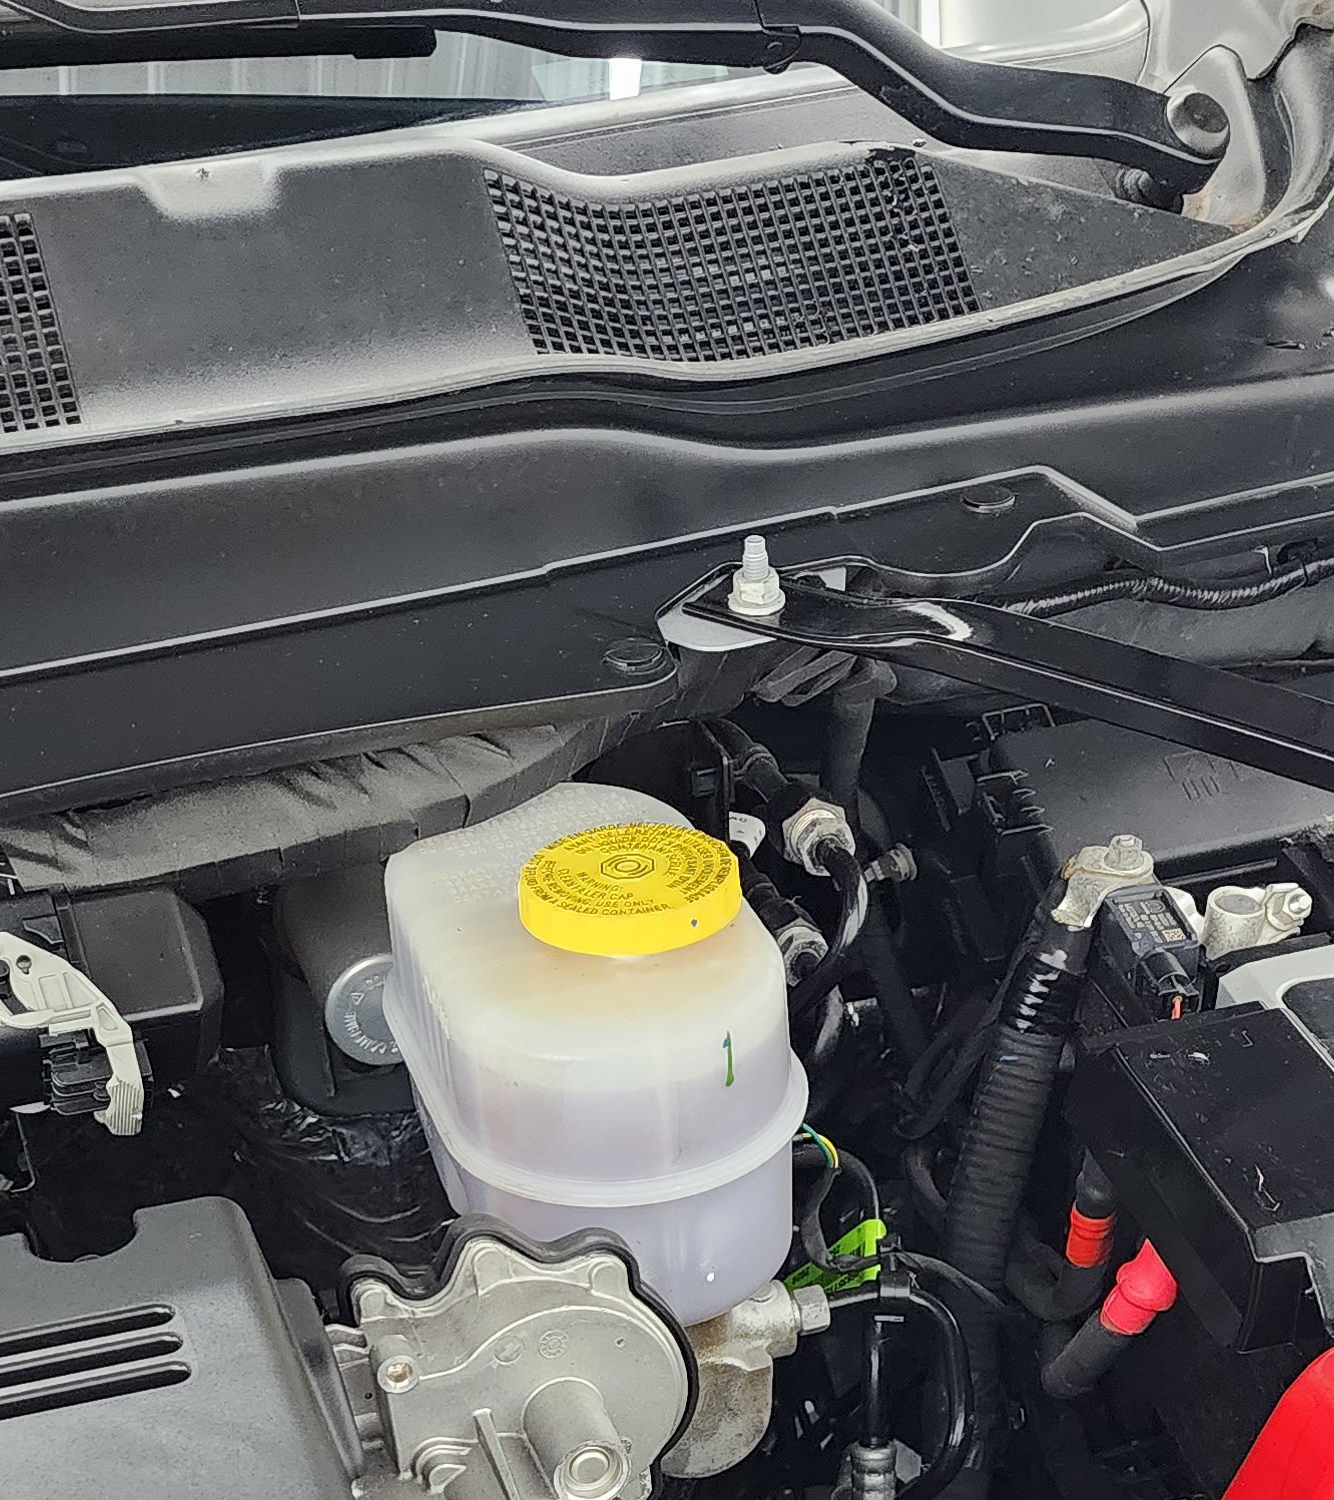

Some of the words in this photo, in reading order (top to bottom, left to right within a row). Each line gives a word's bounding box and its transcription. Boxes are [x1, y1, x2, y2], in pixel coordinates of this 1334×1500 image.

[609, 892, 634, 901] CAP
[595, 900, 619, 908] USE
[624, 898, 655, 907] ONLY
[556, 902, 599, 915] SEALED
